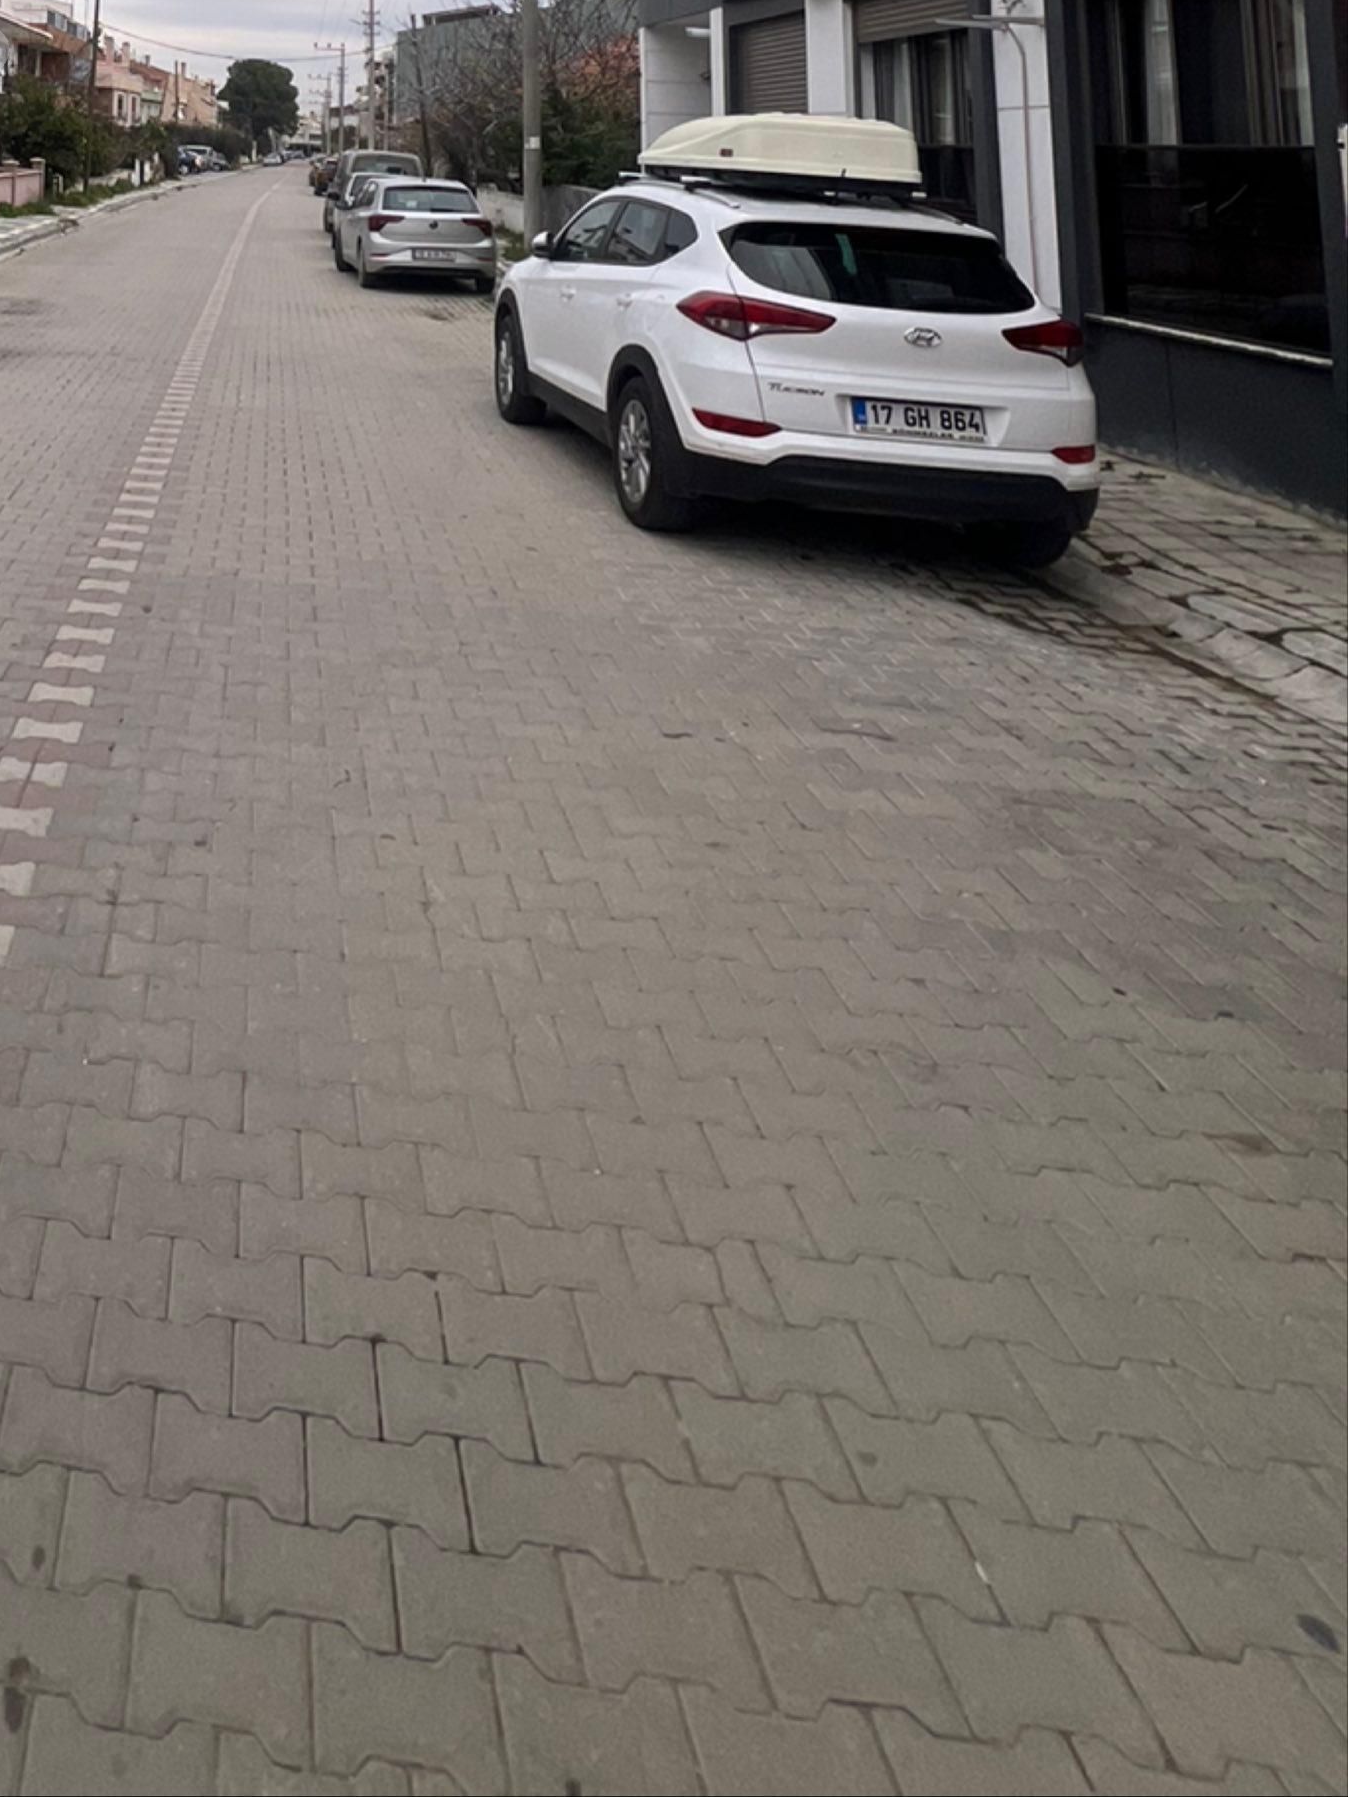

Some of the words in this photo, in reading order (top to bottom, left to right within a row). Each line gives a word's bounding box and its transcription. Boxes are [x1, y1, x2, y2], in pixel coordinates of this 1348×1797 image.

[871, 404, 893, 425] 17
[904, 407, 931, 429] GH
[940, 410, 980, 433] 864
